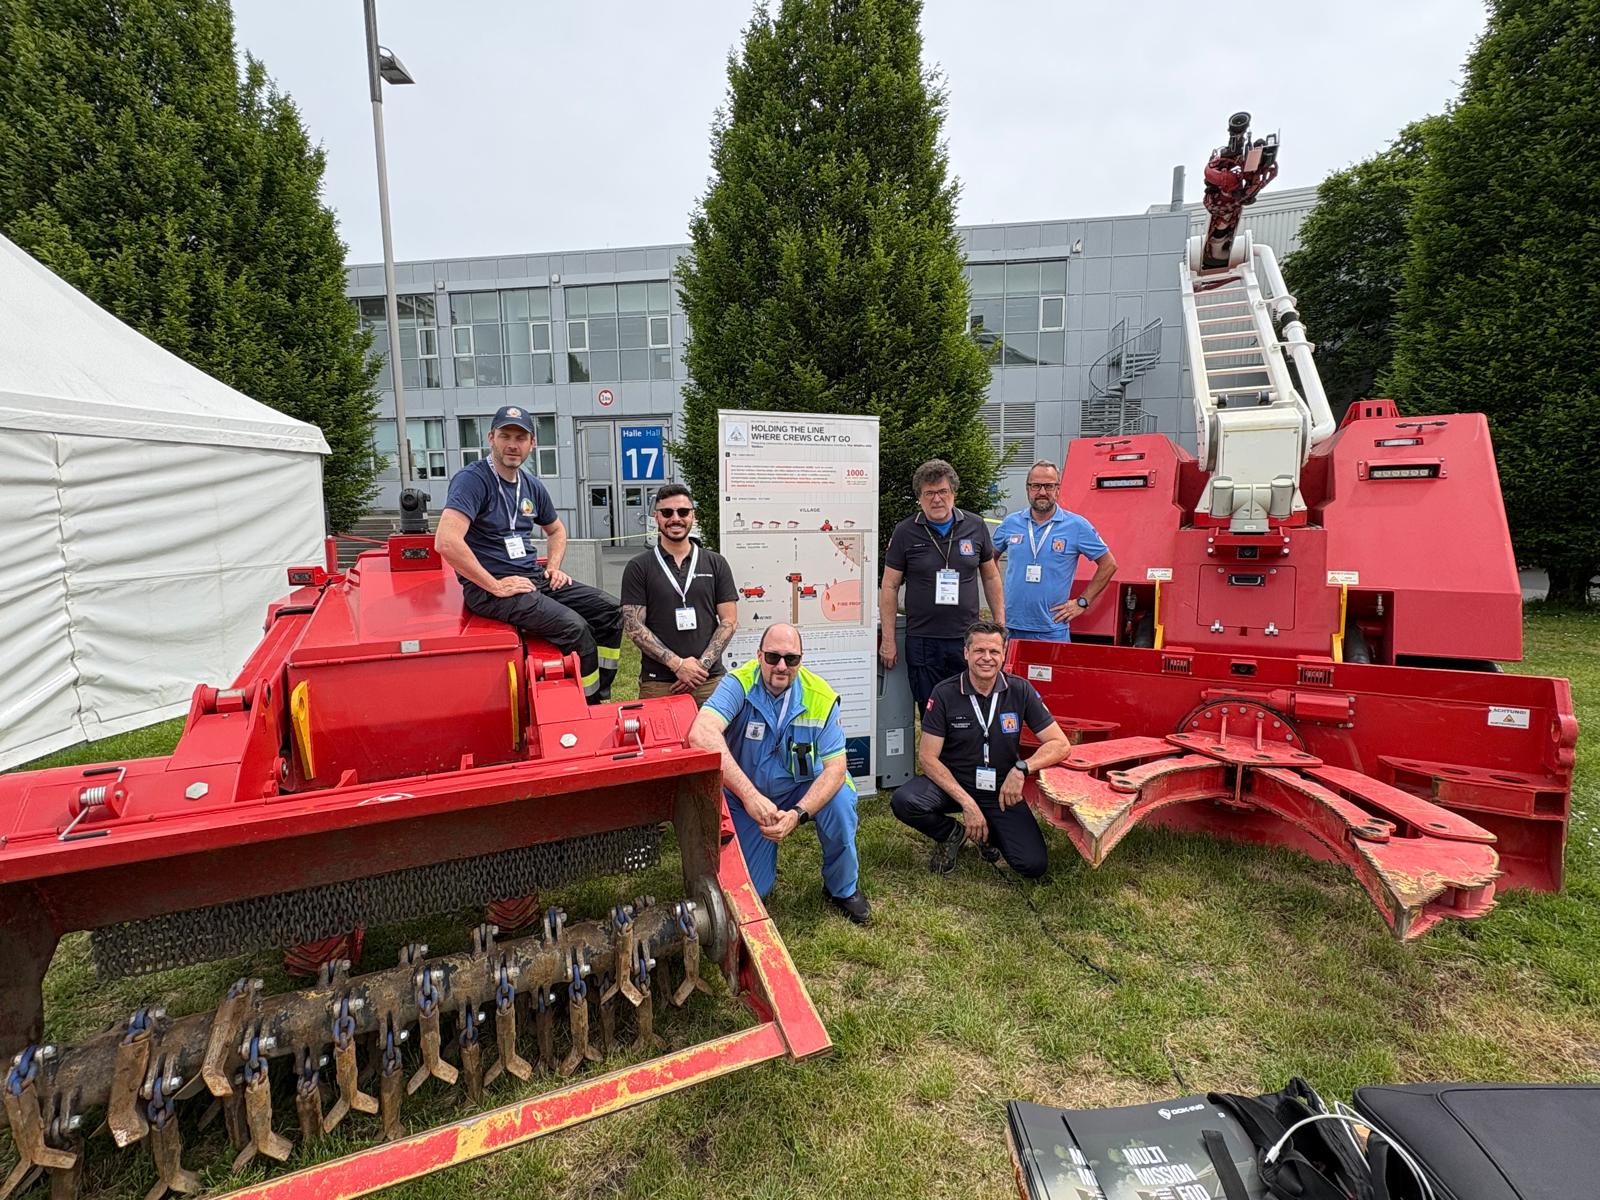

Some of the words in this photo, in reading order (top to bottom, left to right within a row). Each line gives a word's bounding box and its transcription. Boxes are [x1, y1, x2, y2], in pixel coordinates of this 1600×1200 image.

[622, 429, 642, 437] Halle
[645, 429, 660, 437] Hall
[751, 424, 788, 433] HOLDING
[790, 425, 806, 434] THE
[807, 426, 825, 434] LINE
[751, 433, 781, 441] WHERE
[783, 433, 812, 442] CREWS
[813, 434, 837, 443] CAN'T
[838, 435, 851, 443] GO
[626, 448, 659, 478] 17
[846, 469, 865, 477] 1000
[1121, 1146, 1169, 1166] MULTI
[1134, 1163, 1198, 1186] MISSION
